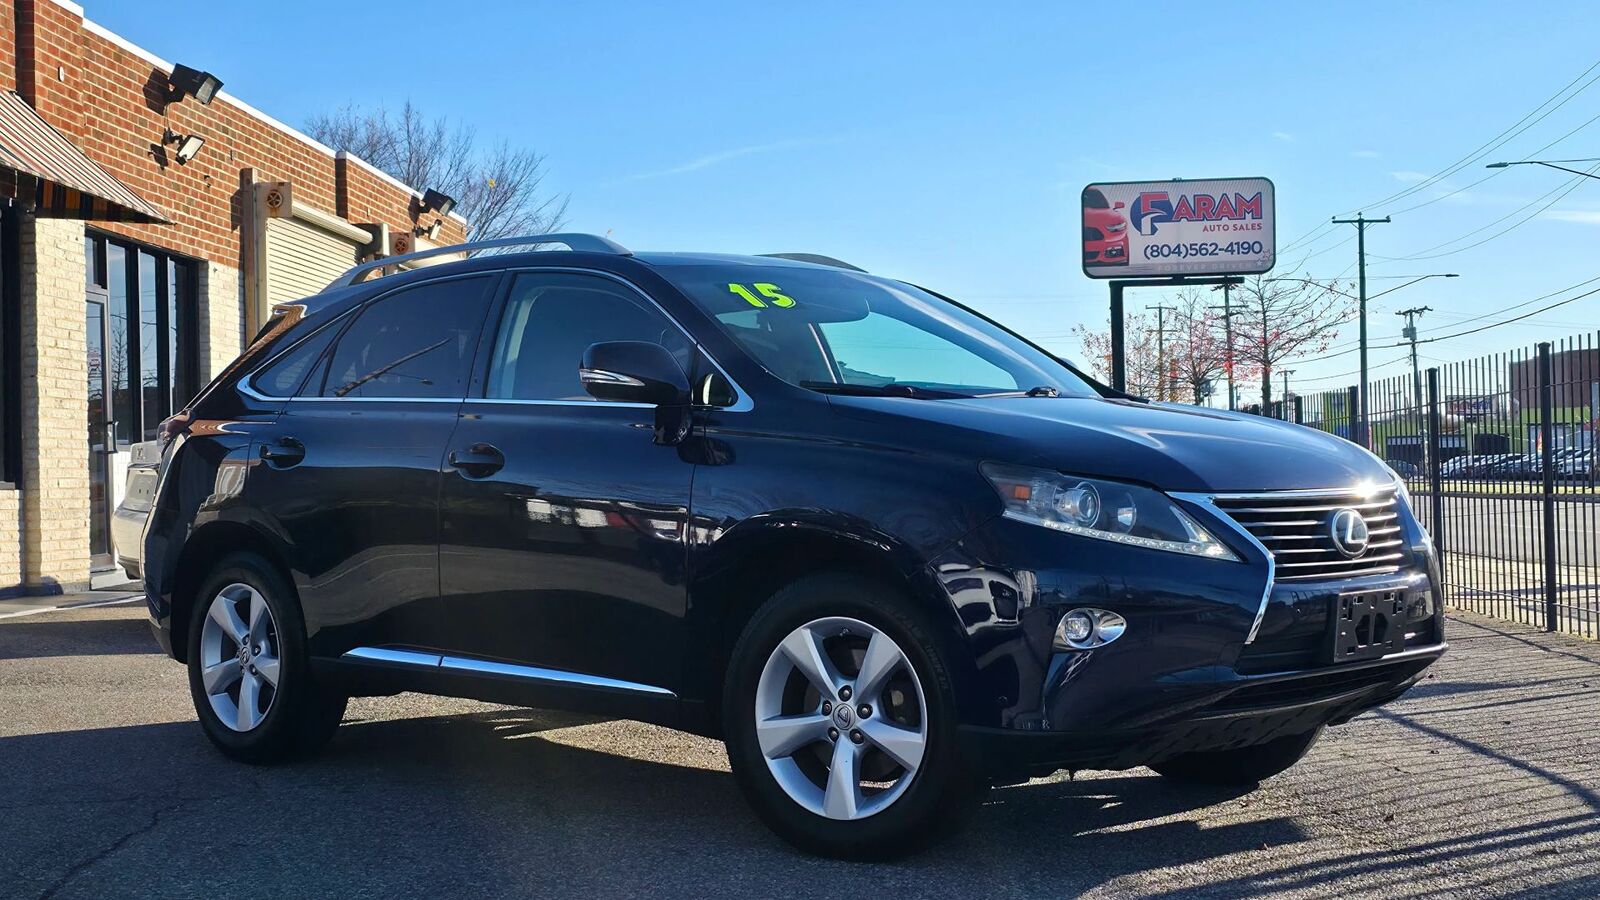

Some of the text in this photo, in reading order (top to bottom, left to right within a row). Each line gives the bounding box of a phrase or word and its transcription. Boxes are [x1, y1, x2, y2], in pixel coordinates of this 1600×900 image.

[1203, 223, 1262, 233] AUTO SALES
[1144, 241, 1263, 260] (804)562-4190
[728, 283, 796, 308] 15
